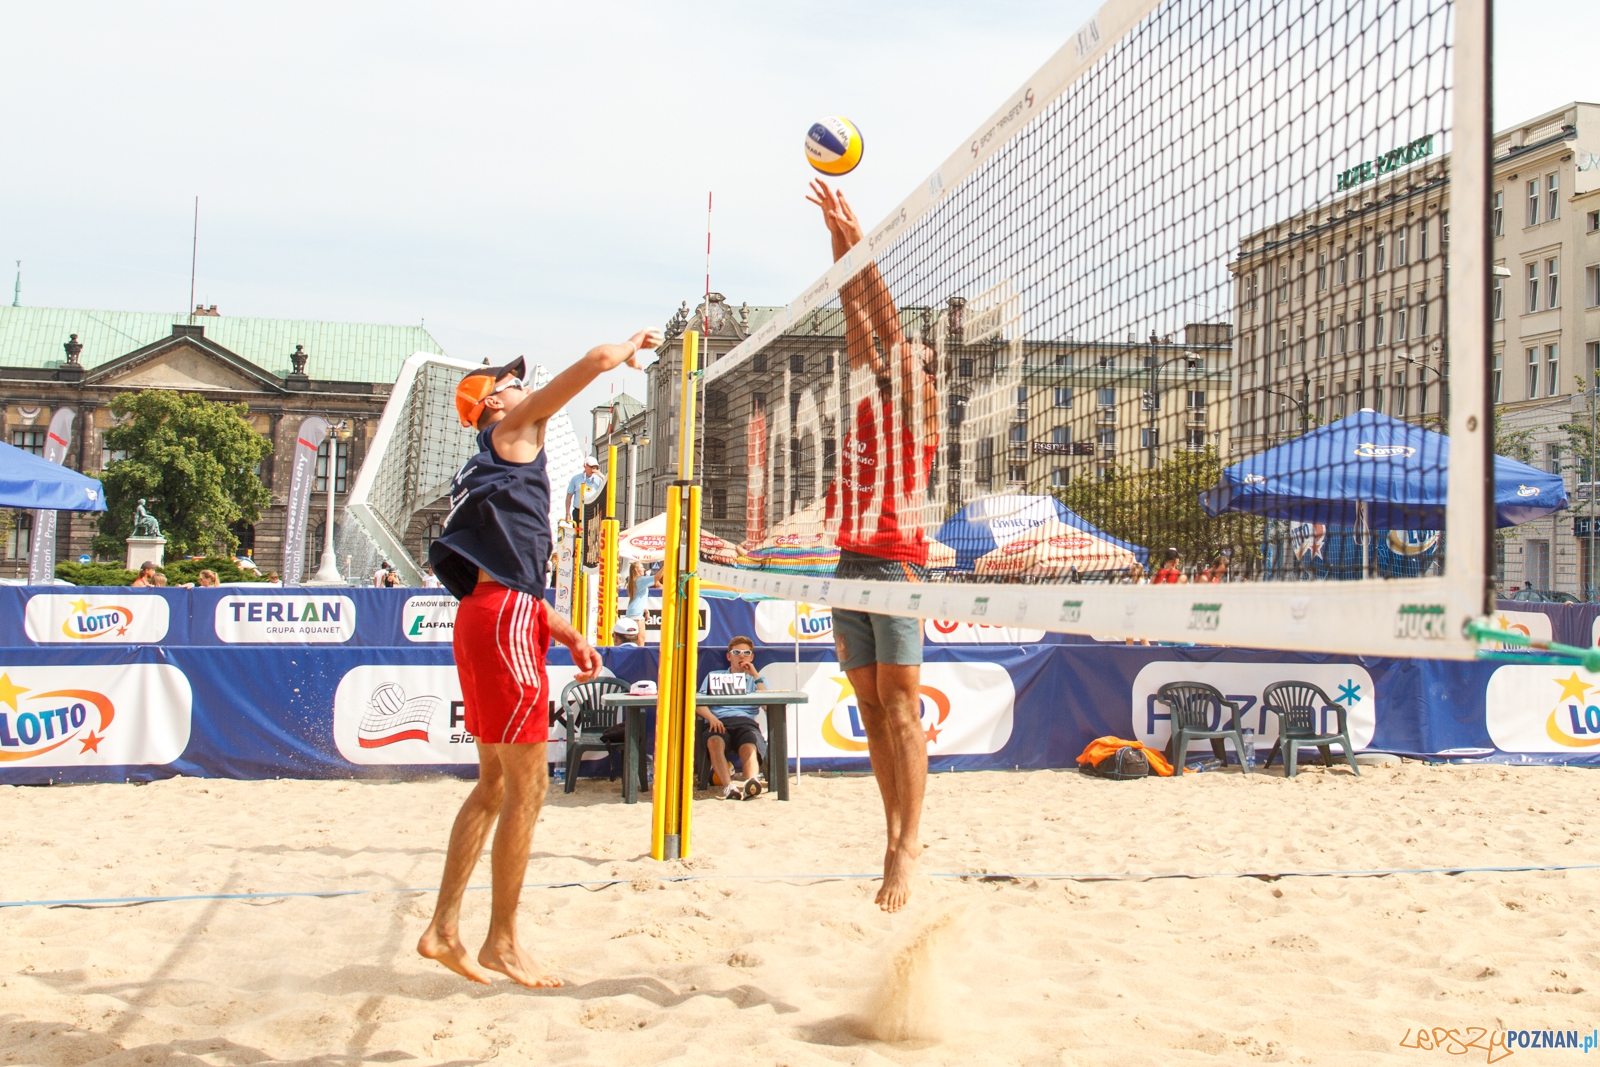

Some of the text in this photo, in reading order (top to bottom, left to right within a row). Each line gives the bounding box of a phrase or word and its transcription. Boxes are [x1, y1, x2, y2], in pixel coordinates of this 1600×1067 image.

[229, 602, 341, 622] TERLAN
[77, 612, 119, 632] LOTTO
[266, 626, 340, 634] GRUPA AQUANET
[801, 616, 834, 634] LOTT
[712, 676, 721, 687] 11
[735, 675, 743, 687] 7
[0, 703, 86, 747] LOTTO
